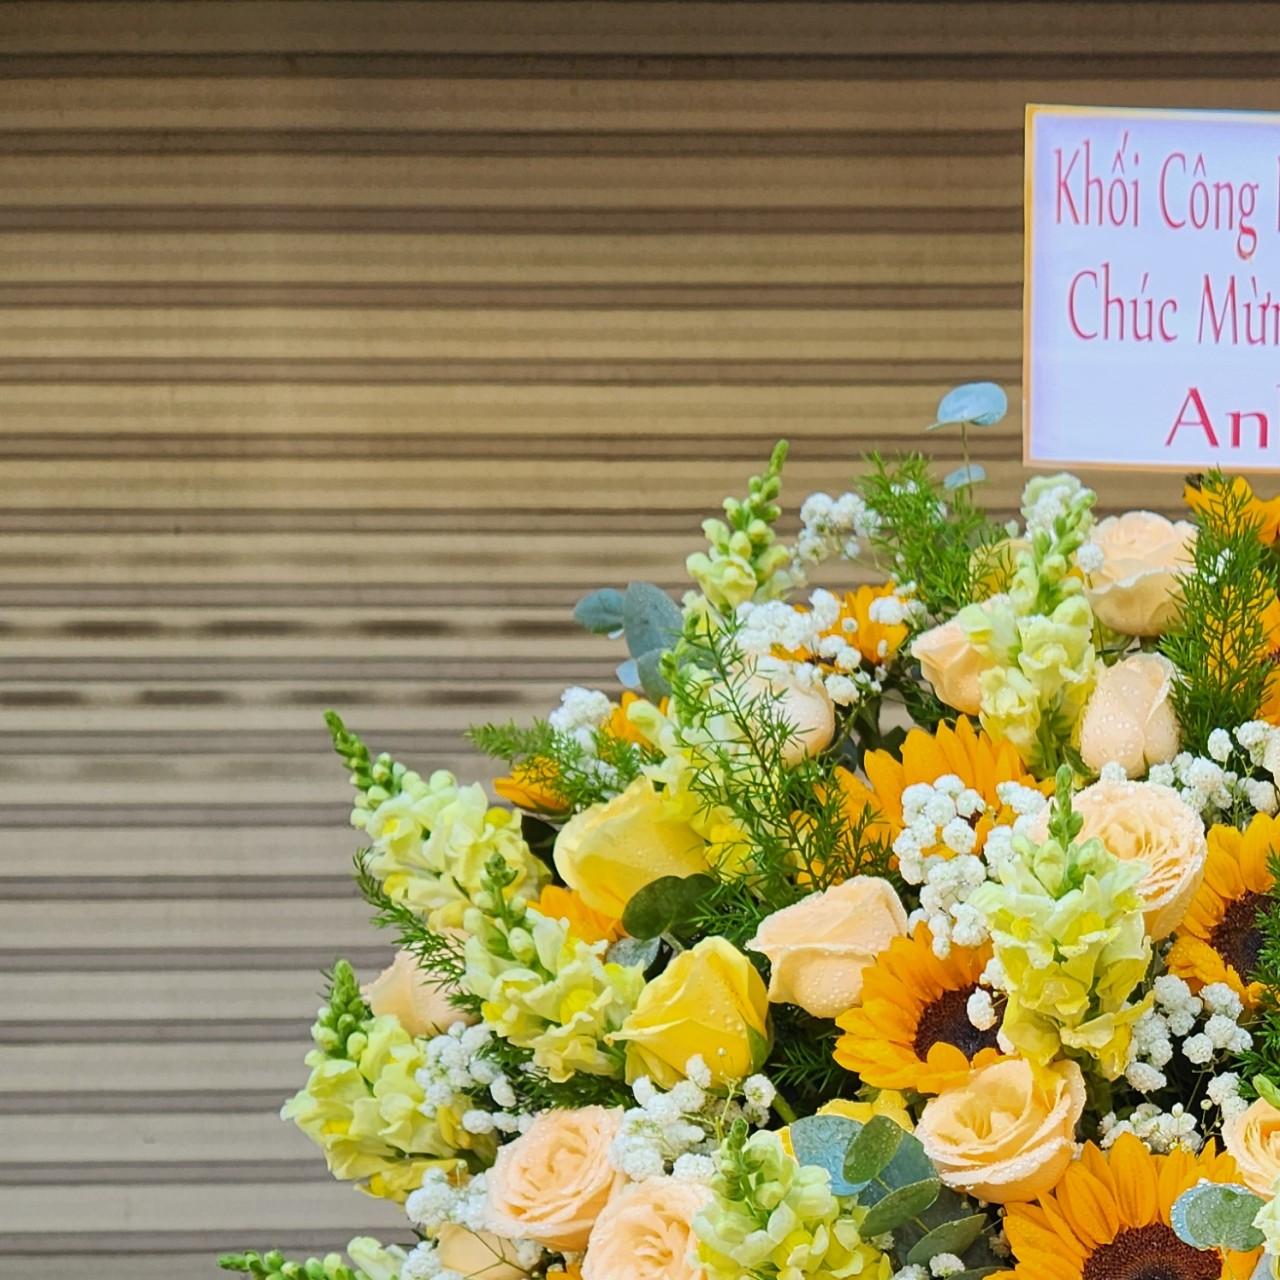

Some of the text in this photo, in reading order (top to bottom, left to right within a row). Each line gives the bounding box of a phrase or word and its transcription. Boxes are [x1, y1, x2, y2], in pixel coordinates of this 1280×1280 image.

[1054, 131, 1140, 227] Khối
[1159, 152, 1259, 260] Công
[1068, 262, 1177, 342] Chúc
